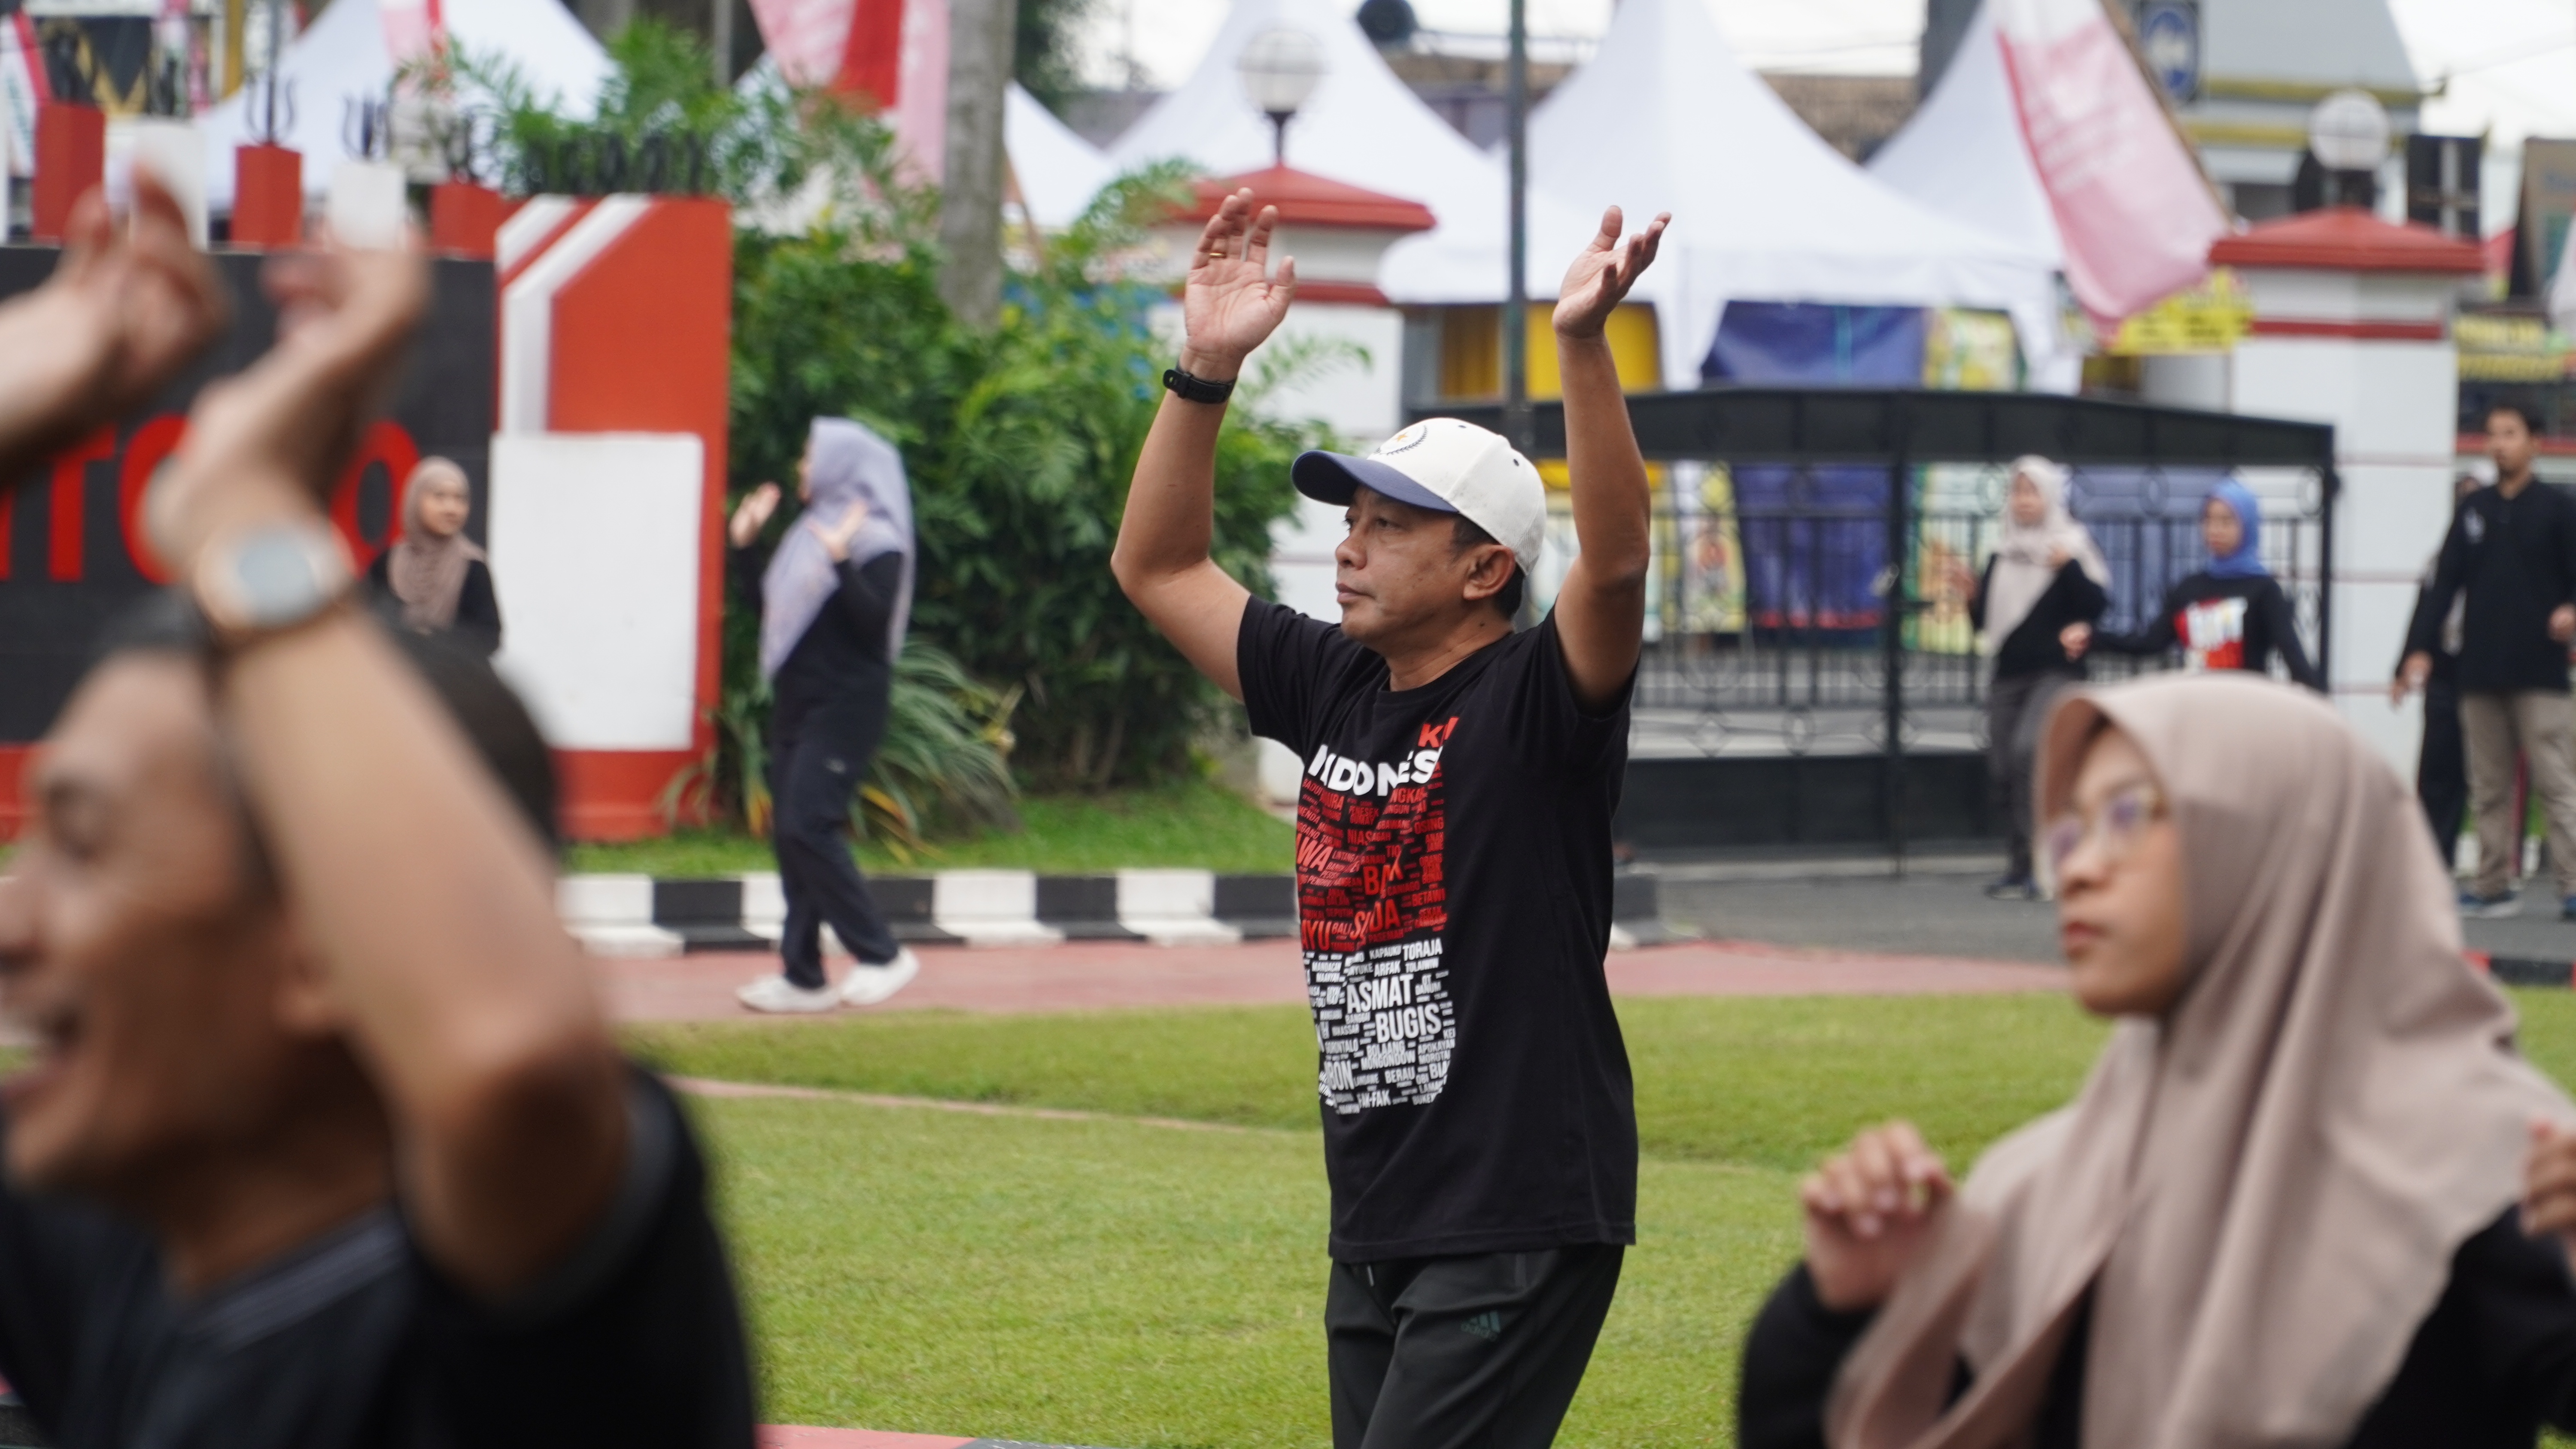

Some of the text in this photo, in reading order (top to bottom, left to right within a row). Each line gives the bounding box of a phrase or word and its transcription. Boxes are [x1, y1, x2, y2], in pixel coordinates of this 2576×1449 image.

[1402, 937, 1443, 961] TORAJA
[1374, 960, 1401, 977] ARFAK
[1346, 973, 1414, 1014] ASMAT
[1375, 1002, 1442, 1044] BUGIS
[1361, 1049, 1416, 1071] MONGONDOW
[1366, 1039, 1406, 1059] BOLAANG
[1385, 1065, 1416, 1084] BERAU
